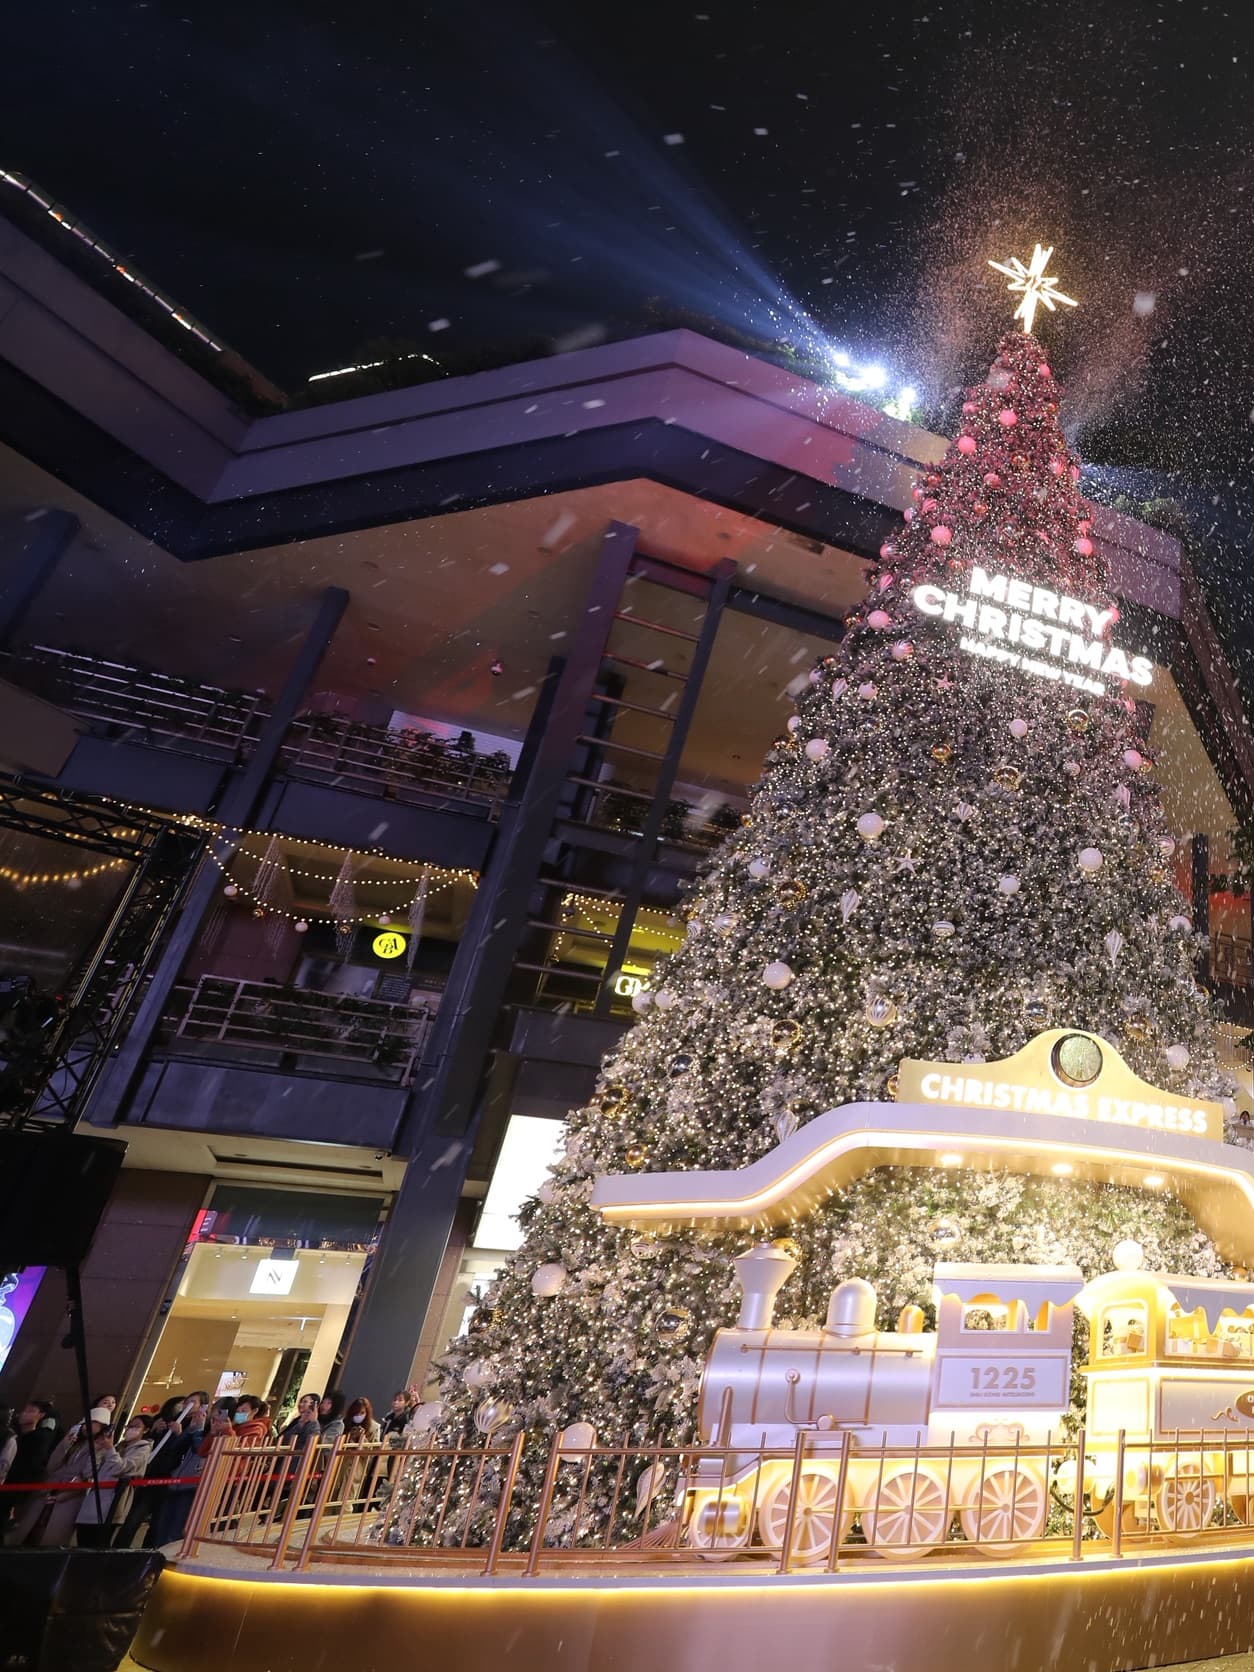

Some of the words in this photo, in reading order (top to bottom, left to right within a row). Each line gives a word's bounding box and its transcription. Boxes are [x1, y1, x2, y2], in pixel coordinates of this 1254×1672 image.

[969, 567, 1113, 635] MERRY
[912, 584, 1153, 687] CHRISTMAS
[920, 1073, 1089, 1118] CHRISTMAS
[1098, 1098, 1208, 1134] EXPRESS
[970, 1366, 1036, 1389] 1225
